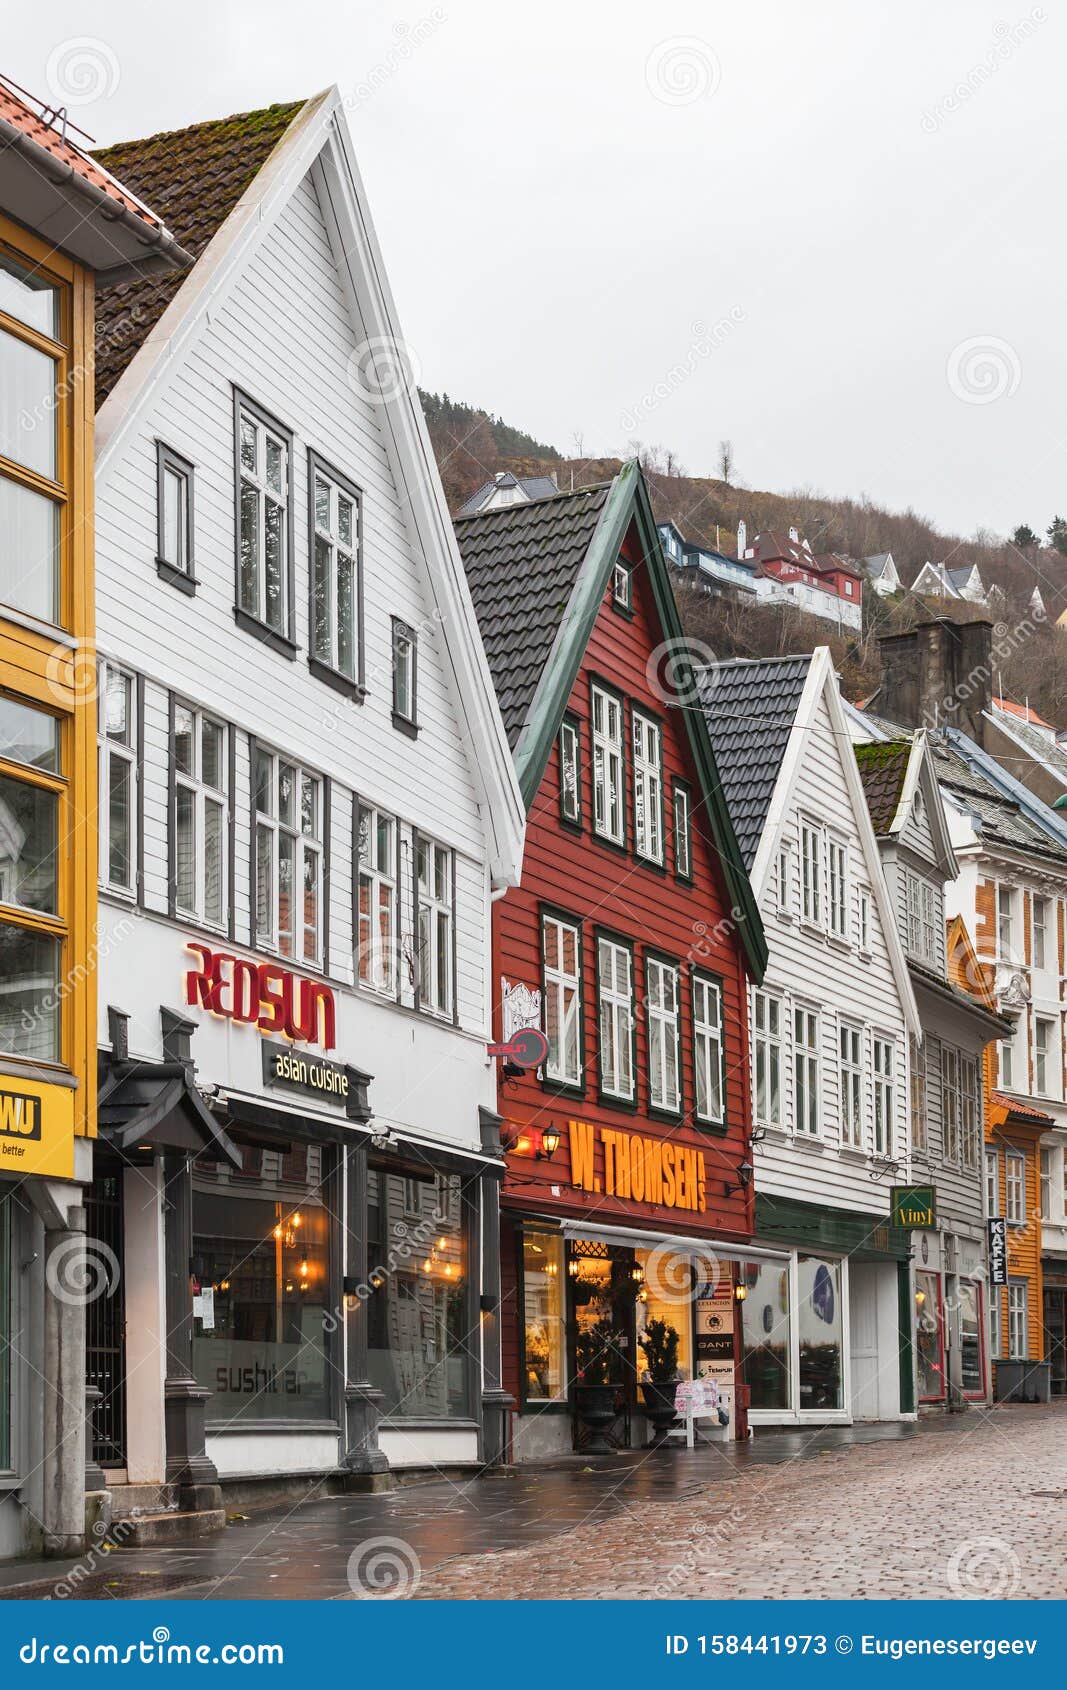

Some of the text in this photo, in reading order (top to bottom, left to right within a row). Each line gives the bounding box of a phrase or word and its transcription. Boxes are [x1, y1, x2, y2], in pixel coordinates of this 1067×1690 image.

[186, 942, 336, 1050] REDSUN
[276, 1052, 349, 1096] asian cuisine
[2, 1143, 25, 1157] better
[569, 1120, 600, 1193] W.
[601, 1128, 698, 1211] THOMSEN
[900, 1208, 931, 1225] Vinyl
[991, 1221, 1005, 1283] KAFFE
[698, 1341, 731, 1349] GANT
